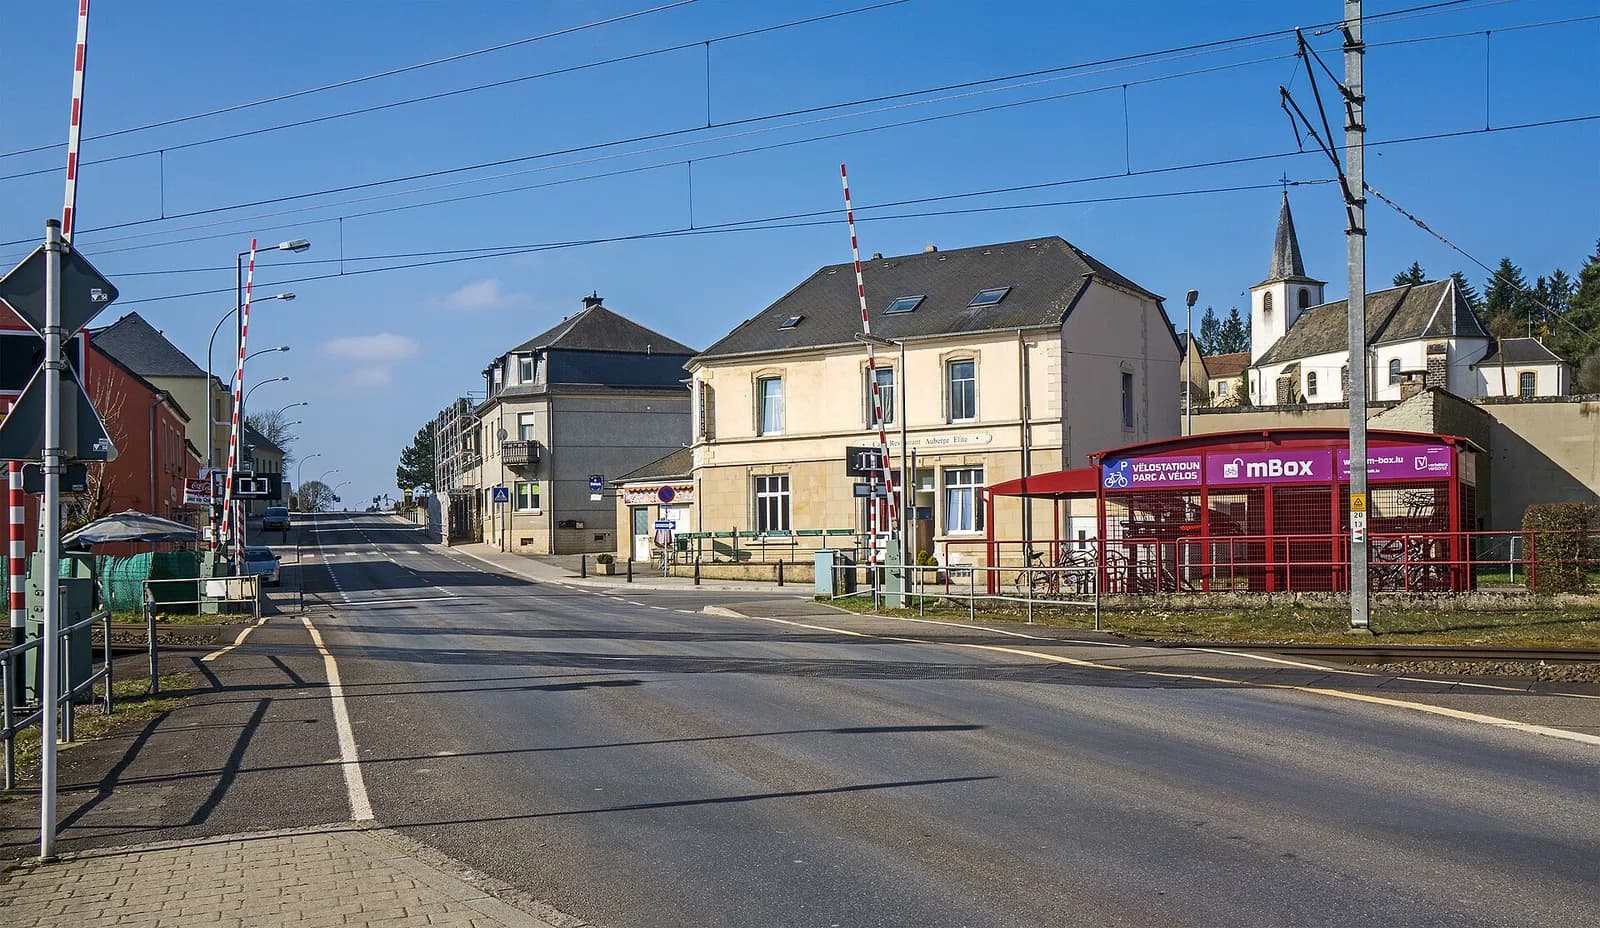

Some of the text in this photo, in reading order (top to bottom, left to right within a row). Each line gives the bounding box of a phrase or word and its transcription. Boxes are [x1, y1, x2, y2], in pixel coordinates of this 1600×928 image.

[1120, 461, 1128, 471] P
[1132, 461, 1200, 472] VËLOSTATIOUN
[1246, 458, 1314, 478] mBox
[1132, 471, 1198, 482] PARC À VÉLOS
